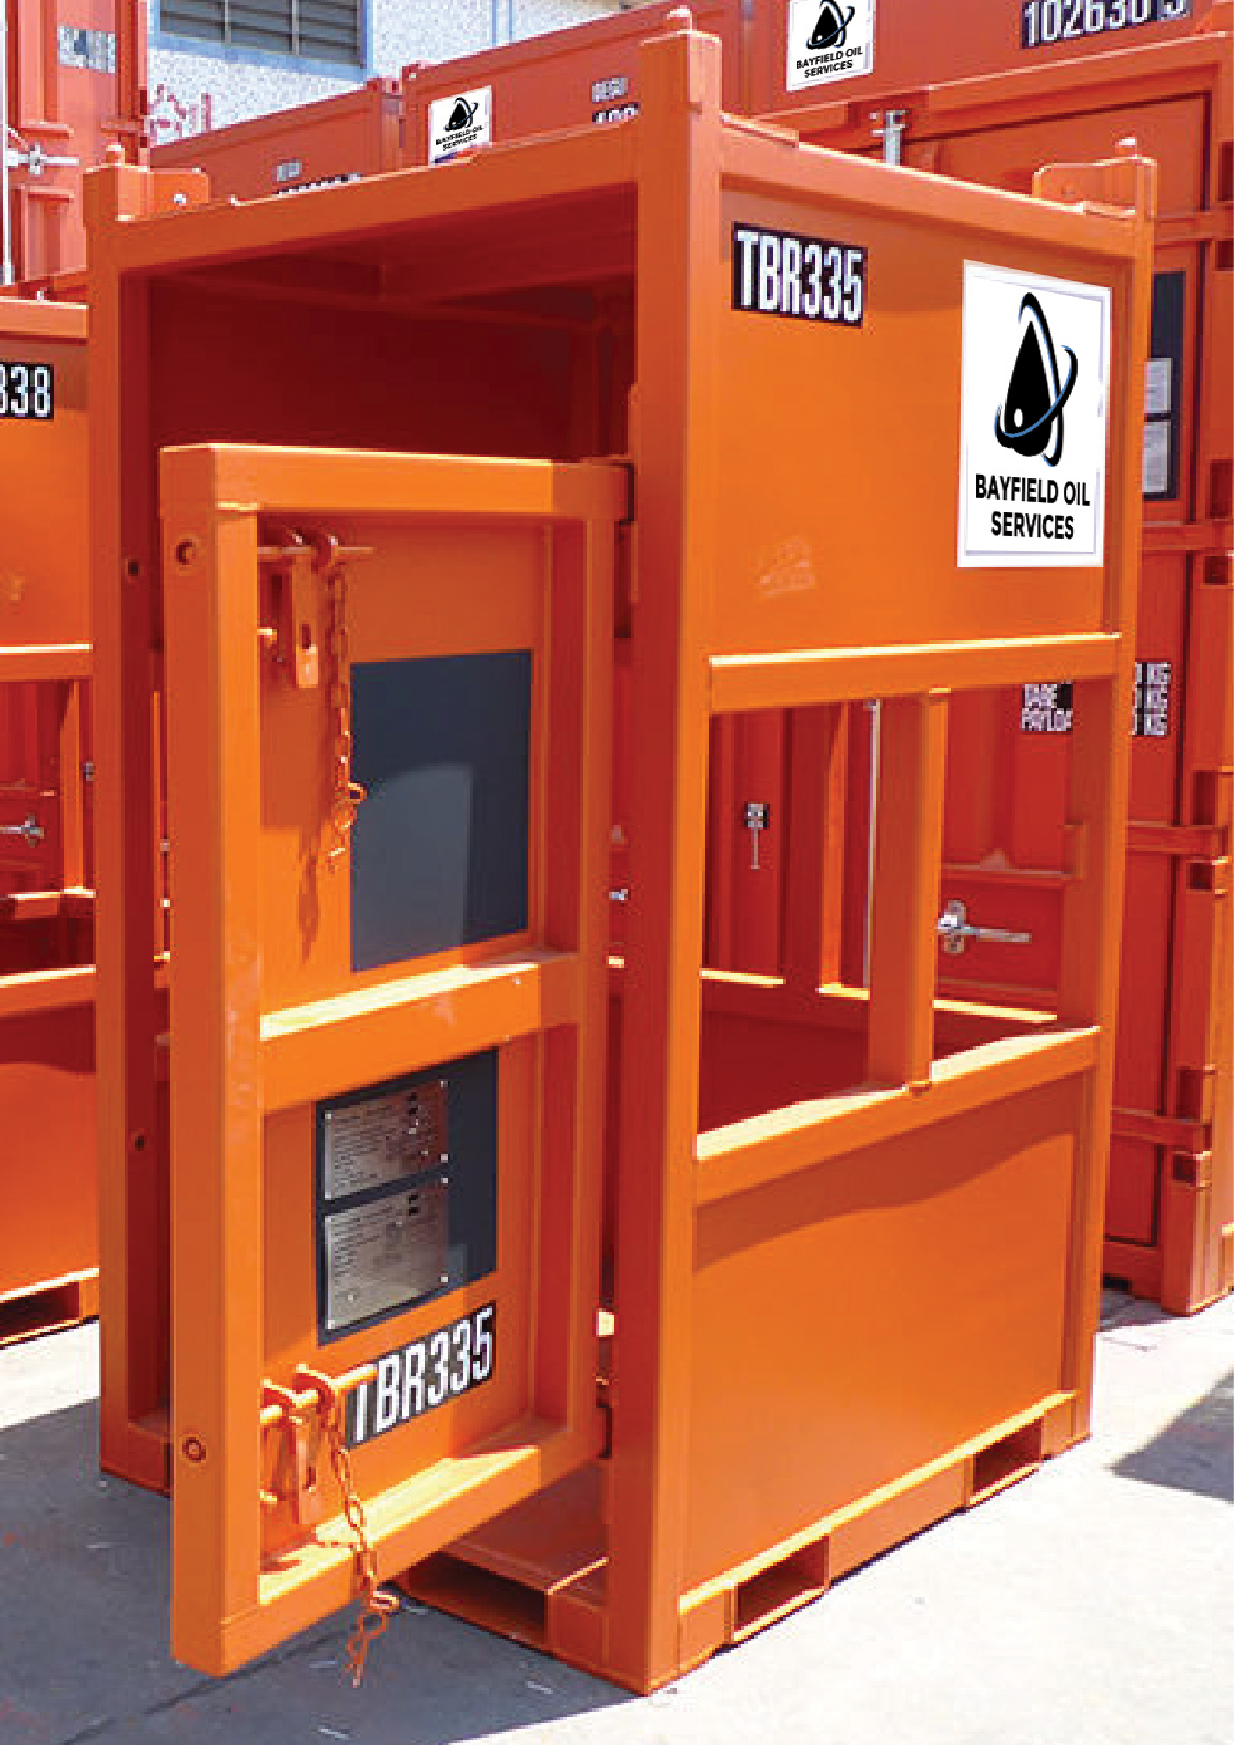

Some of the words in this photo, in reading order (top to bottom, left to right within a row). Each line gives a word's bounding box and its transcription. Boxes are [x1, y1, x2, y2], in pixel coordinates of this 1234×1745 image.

[797, 51, 844, 69] BAYFIELD
[845, 46, 864, 58] OIL
[804, 60, 853, 78] SERVICES
[736, 229, 863, 322] TBR335
[975, 473, 1059, 503] BAYFIELD
[1064, 481, 1091, 506] OIL
[991, 511, 1074, 540] SERVICES
